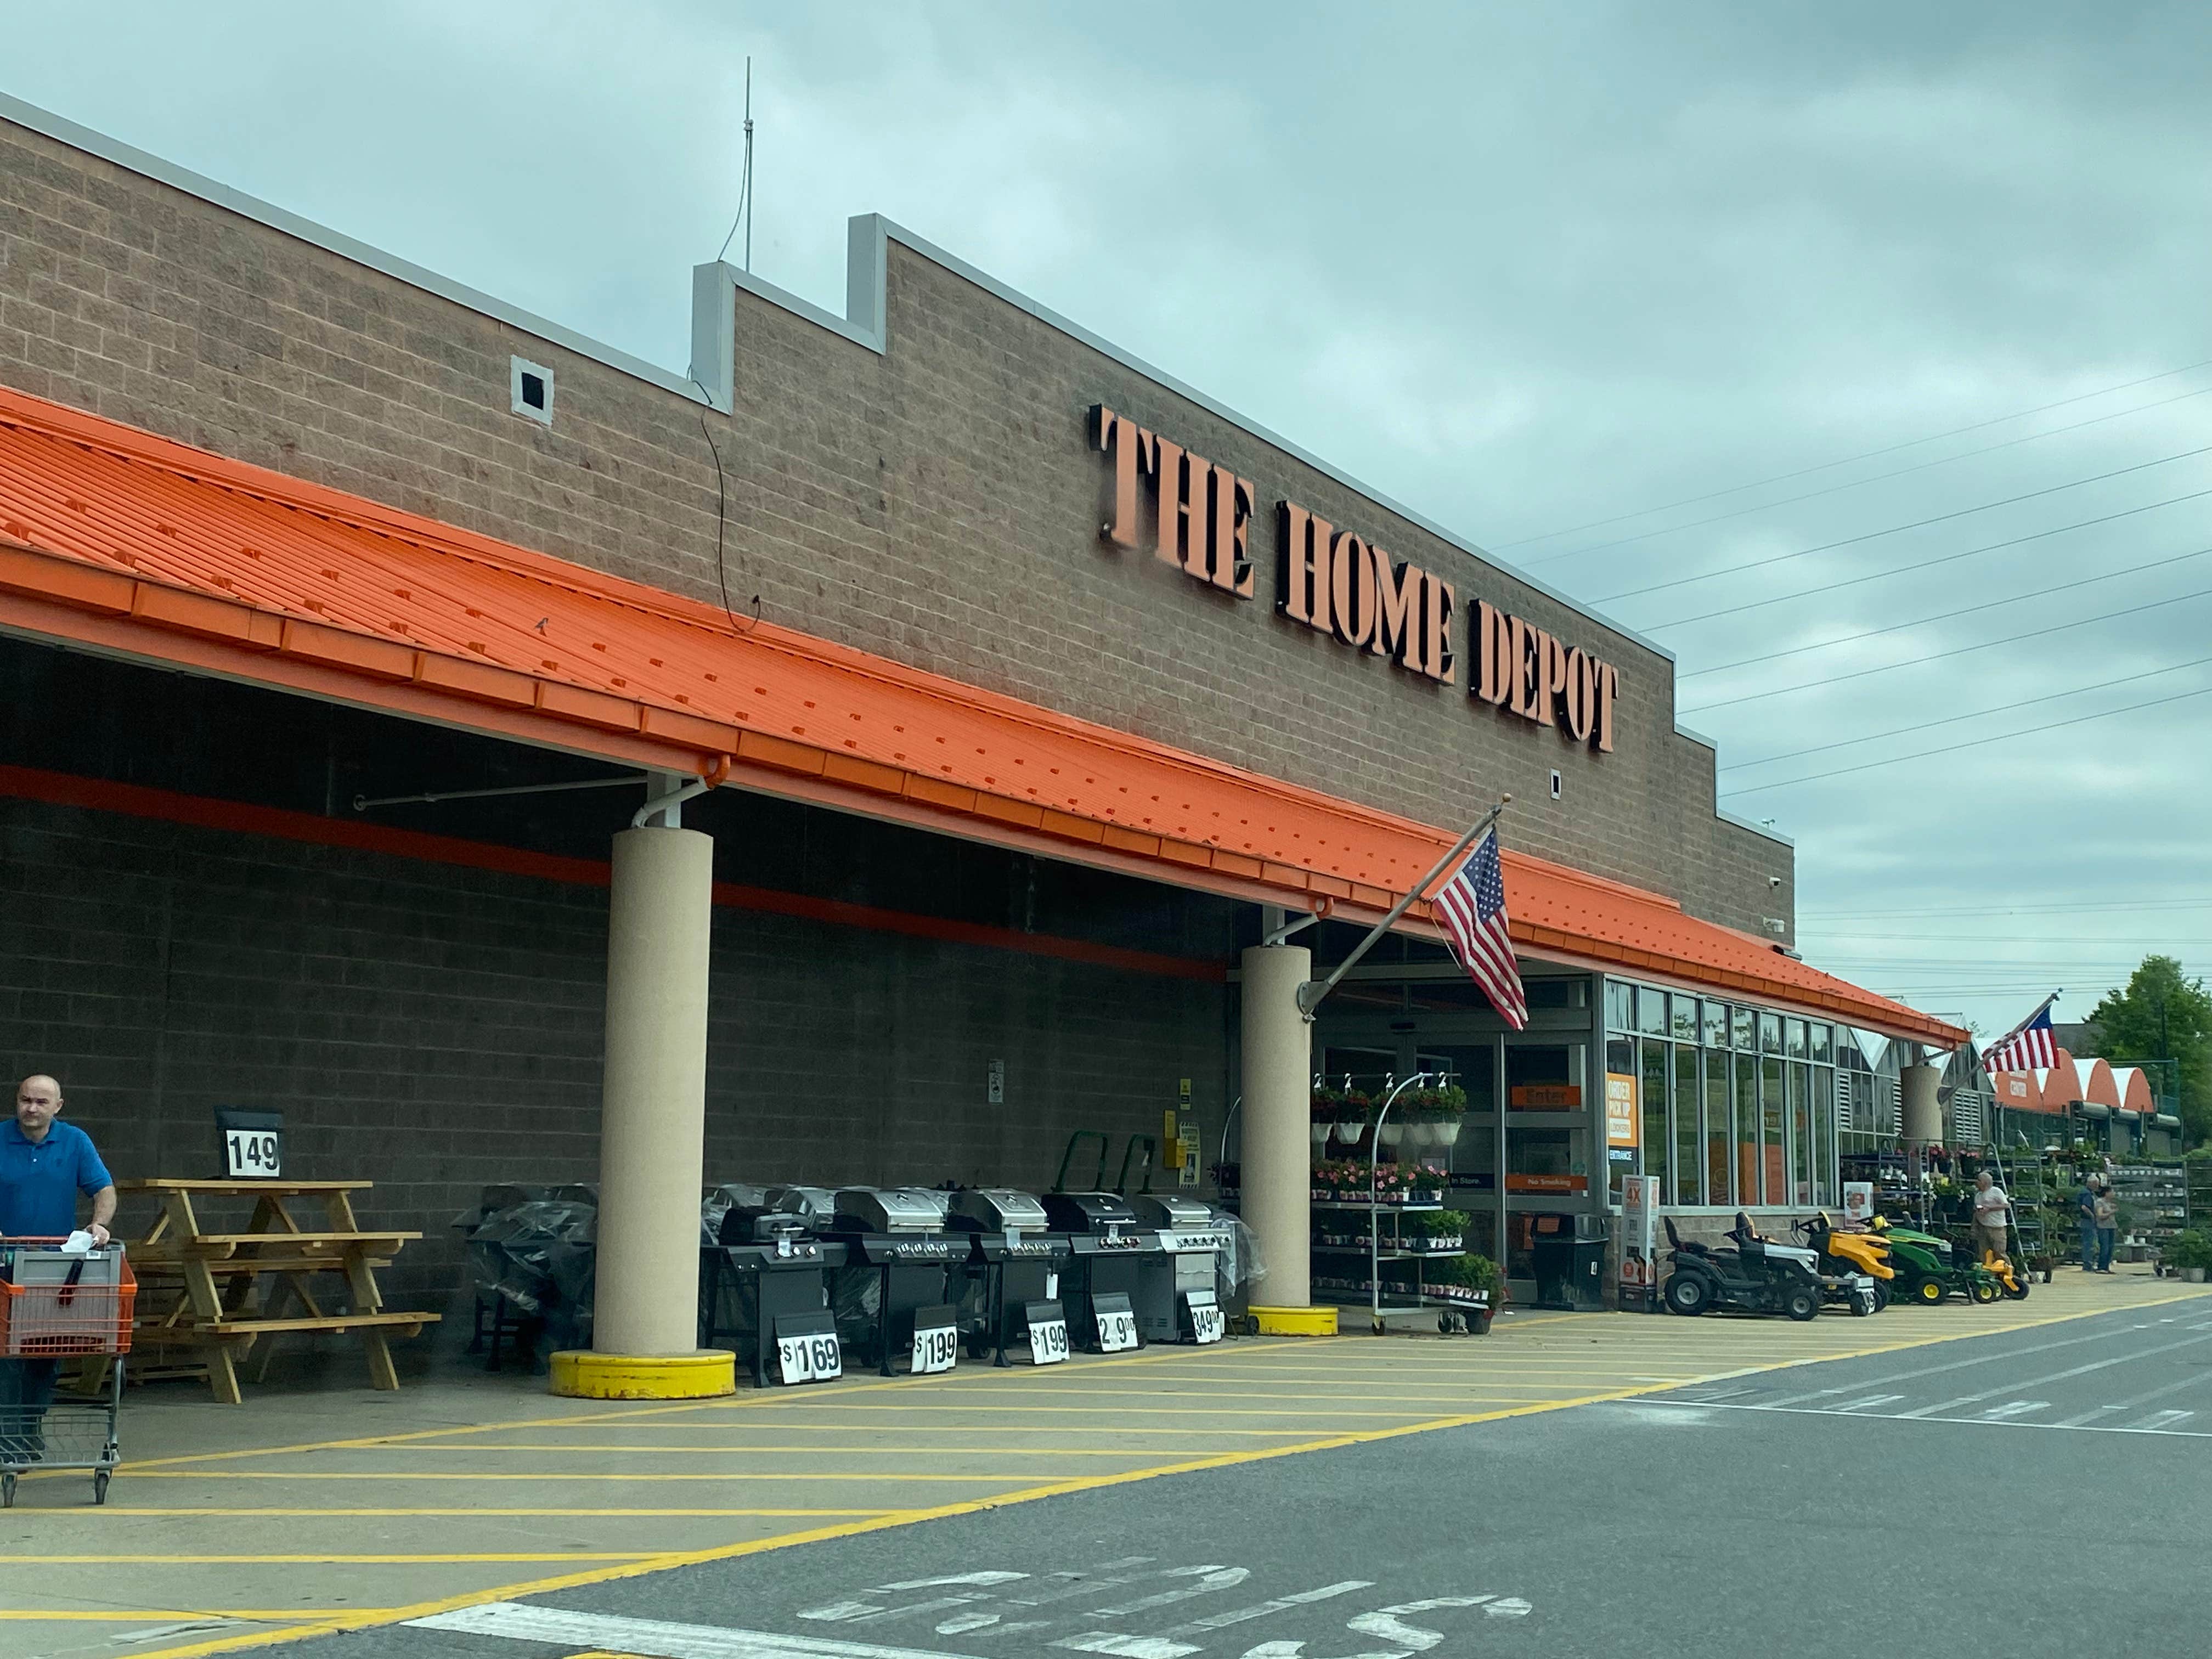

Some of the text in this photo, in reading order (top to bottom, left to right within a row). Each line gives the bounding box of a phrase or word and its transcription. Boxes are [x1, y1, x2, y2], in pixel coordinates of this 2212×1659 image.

[1091, 404, 1618, 753] THE HOME DEPOT
[1608, 1080, 1630, 1101] ORDER
[1622, 1102, 1631, 1118] UP
[229, 1136, 278, 1170] 149
[1540, 1178, 1572, 1187] Smoking
[783, 1339, 839, 1372] $169
[916, 1331, 956, 1365] $199
[1032, 1325, 1066, 1356] $199
